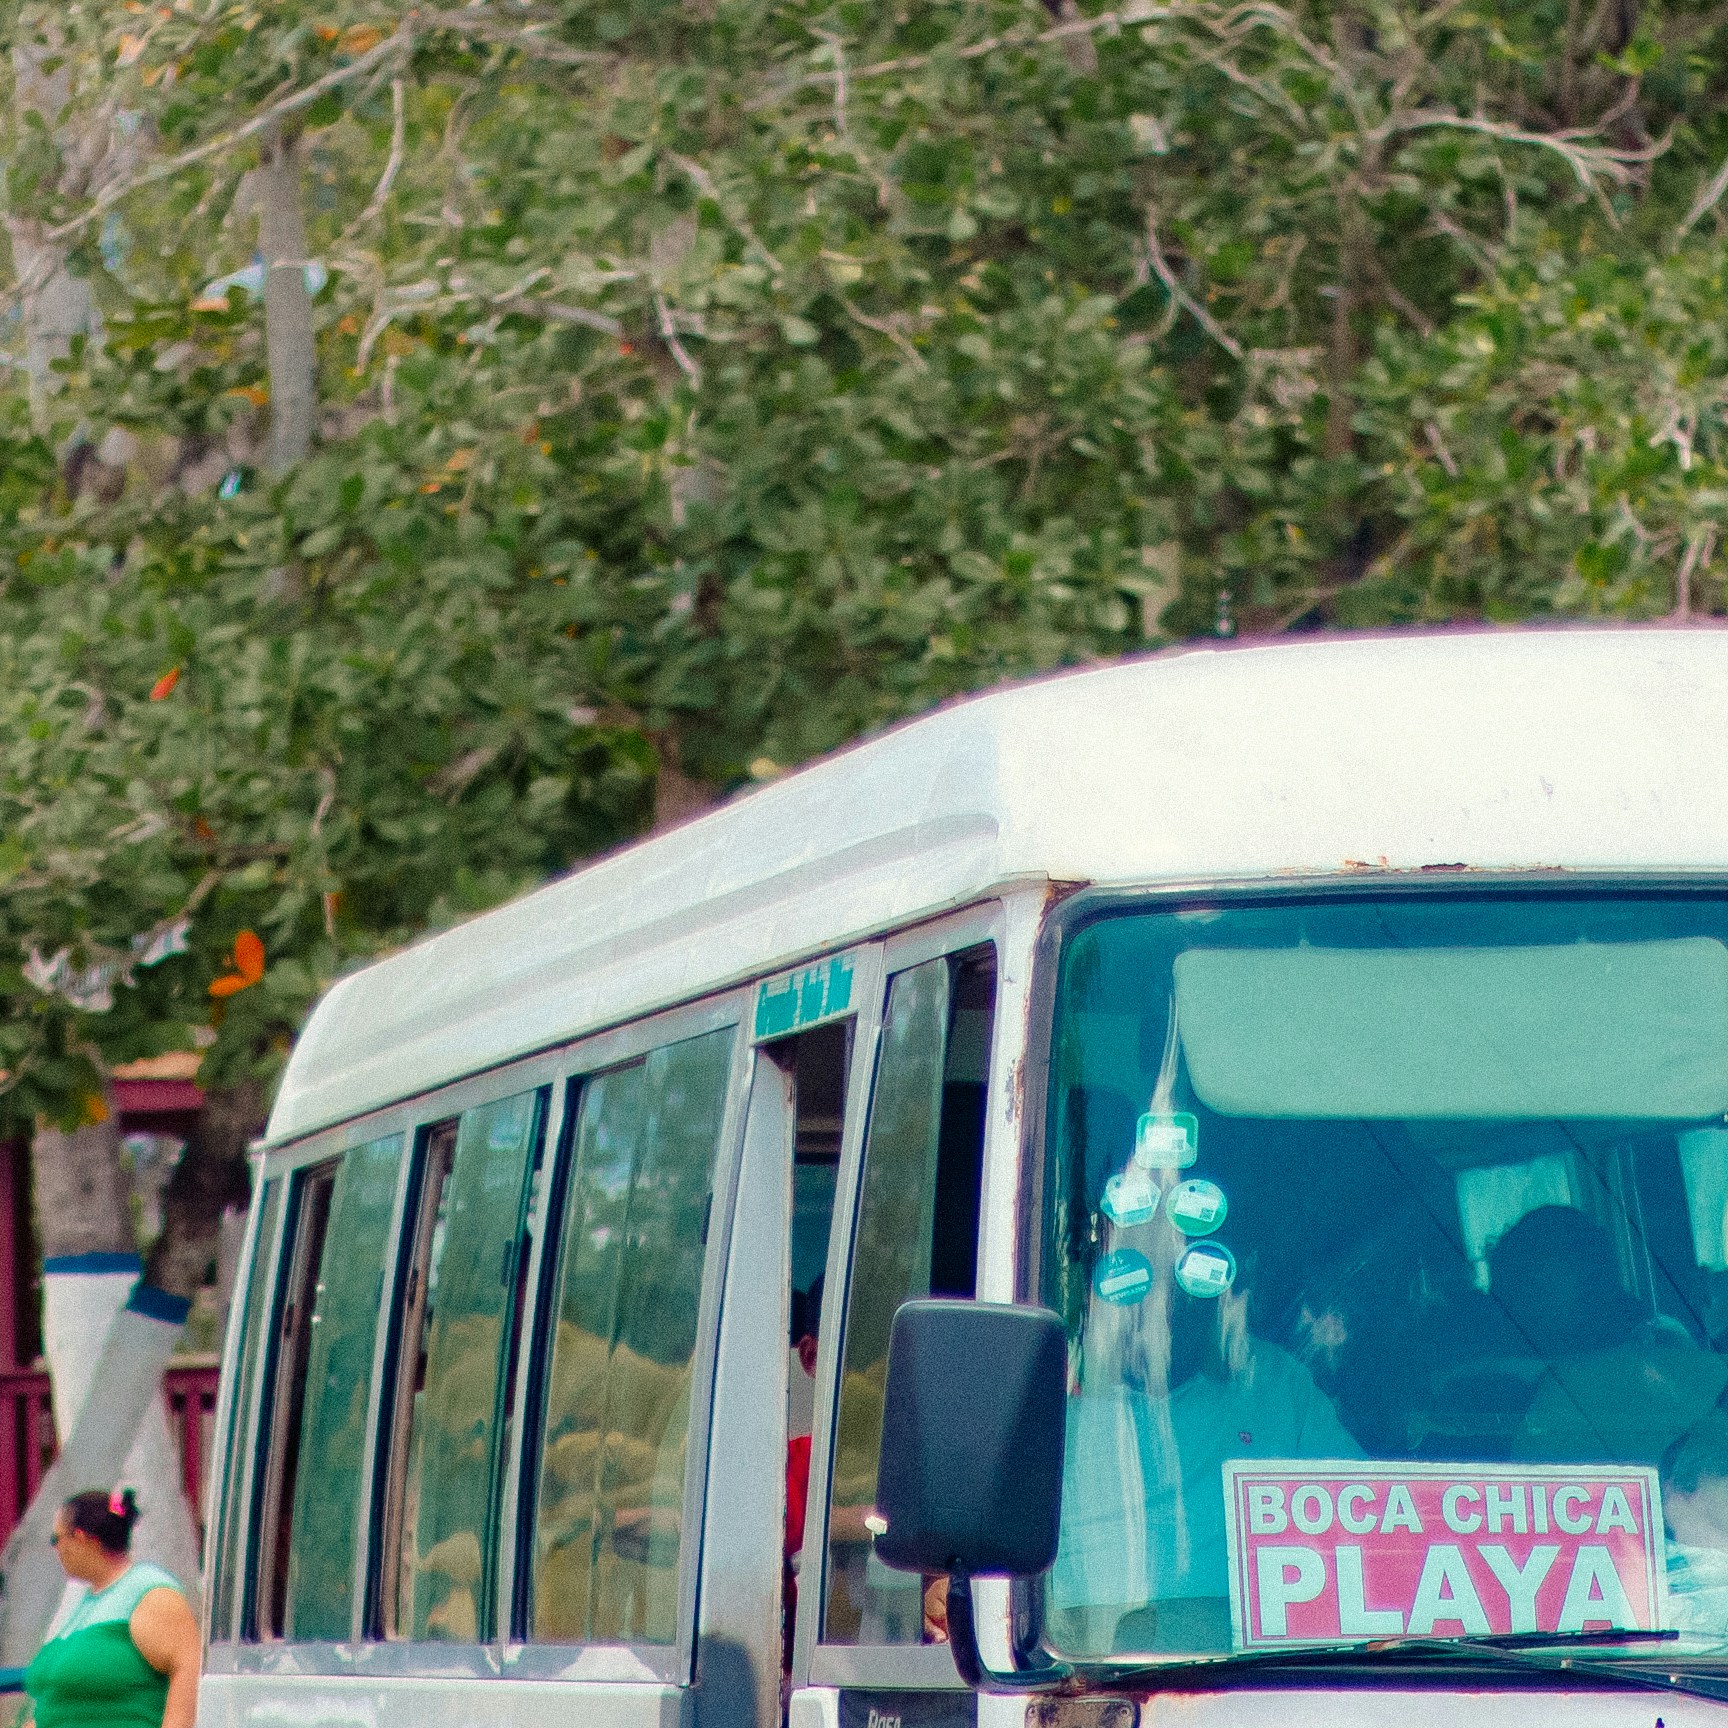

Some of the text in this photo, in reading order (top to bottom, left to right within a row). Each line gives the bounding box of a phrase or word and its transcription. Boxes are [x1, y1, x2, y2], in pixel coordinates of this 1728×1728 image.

[1246, 1483, 1639, 1535] BOCA CHICA
[1255, 1543, 1642, 1637] PLAYA
